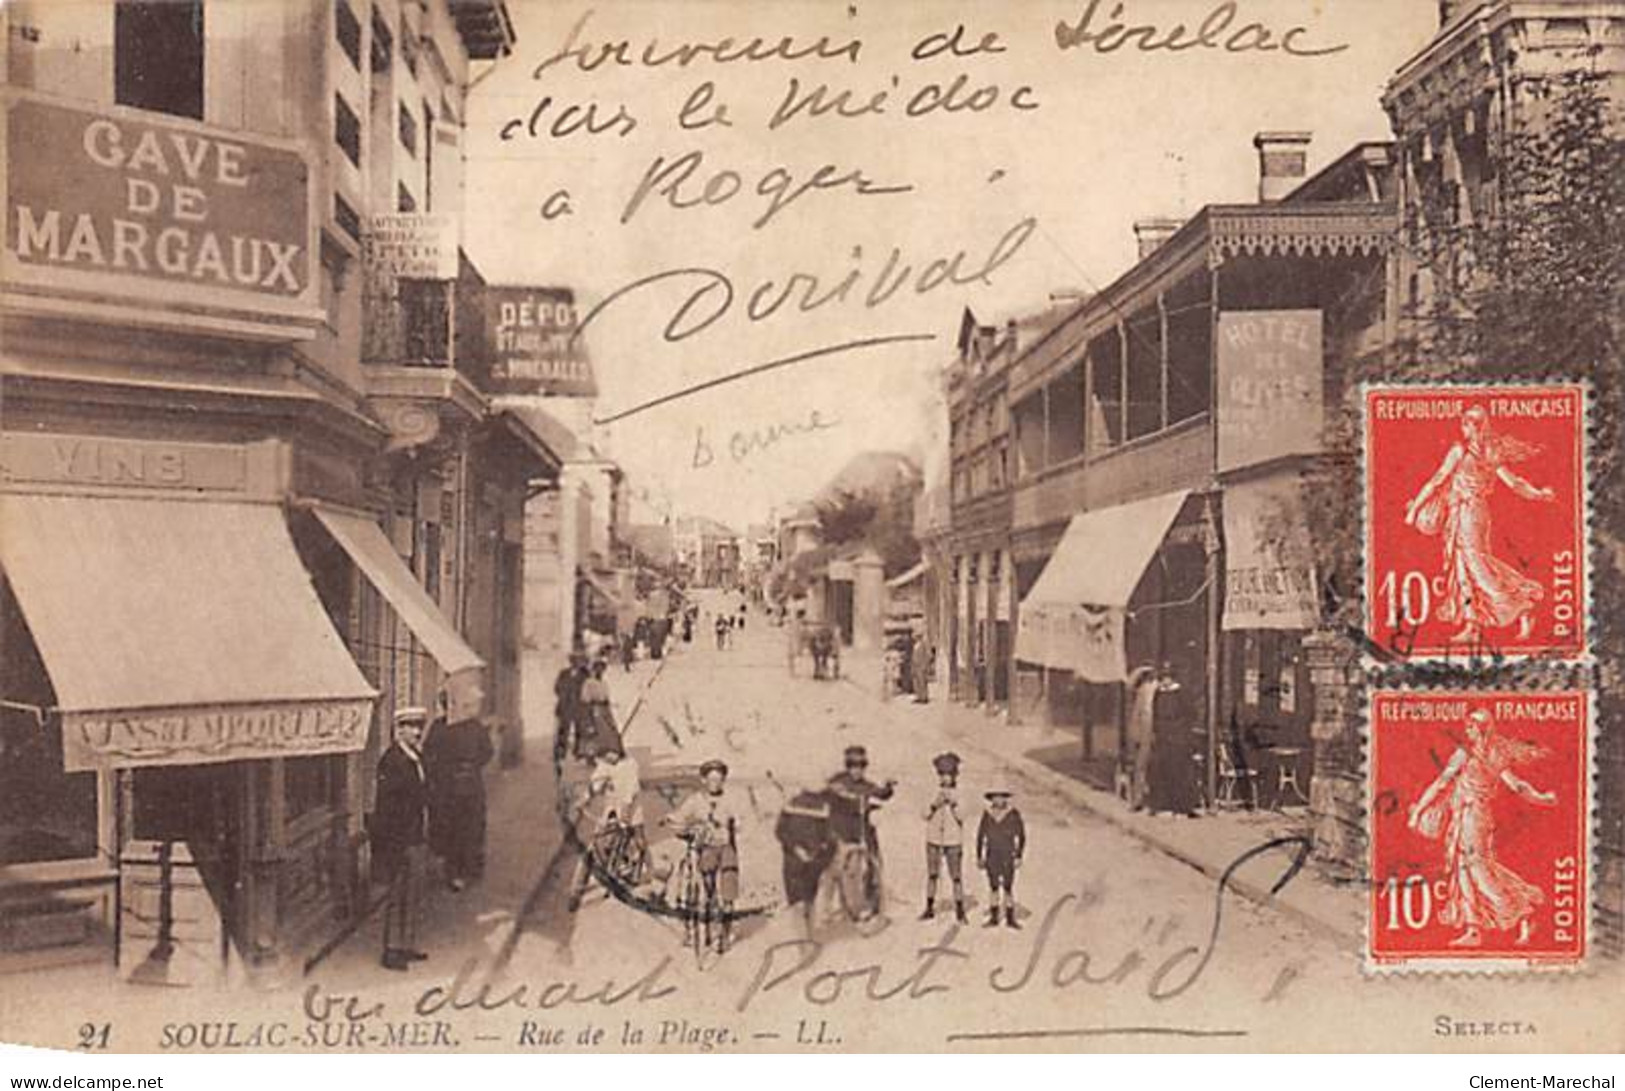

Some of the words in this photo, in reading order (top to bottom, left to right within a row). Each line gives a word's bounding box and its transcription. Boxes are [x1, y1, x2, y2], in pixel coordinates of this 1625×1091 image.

[911, 24, 1006, 60] de
[678, 81, 733, 129] le
[83, 120, 249, 187] CAVE
[126, 177, 208, 221] DE
[620, 150, 913, 230] Roger
[15, 204, 300, 291] MARGAUX
[1490, 398, 1572, 419] FRANÇAISE
[54, 440, 186, 483] VINS
[1553, 550, 1573, 636] POSTES
[1495, 701, 1577, 720] FRANÇAISE
[1554, 856, 1575, 942] POSTES
[737, 924, 969, 1013] Port
[76, 1022, 112, 1049] 21
[517, 1021, 565, 1046] Rue
[576, 1020, 605, 1046] de
[620, 1021, 644, 1046] la
[658, 1020, 739, 1053] Plage.
